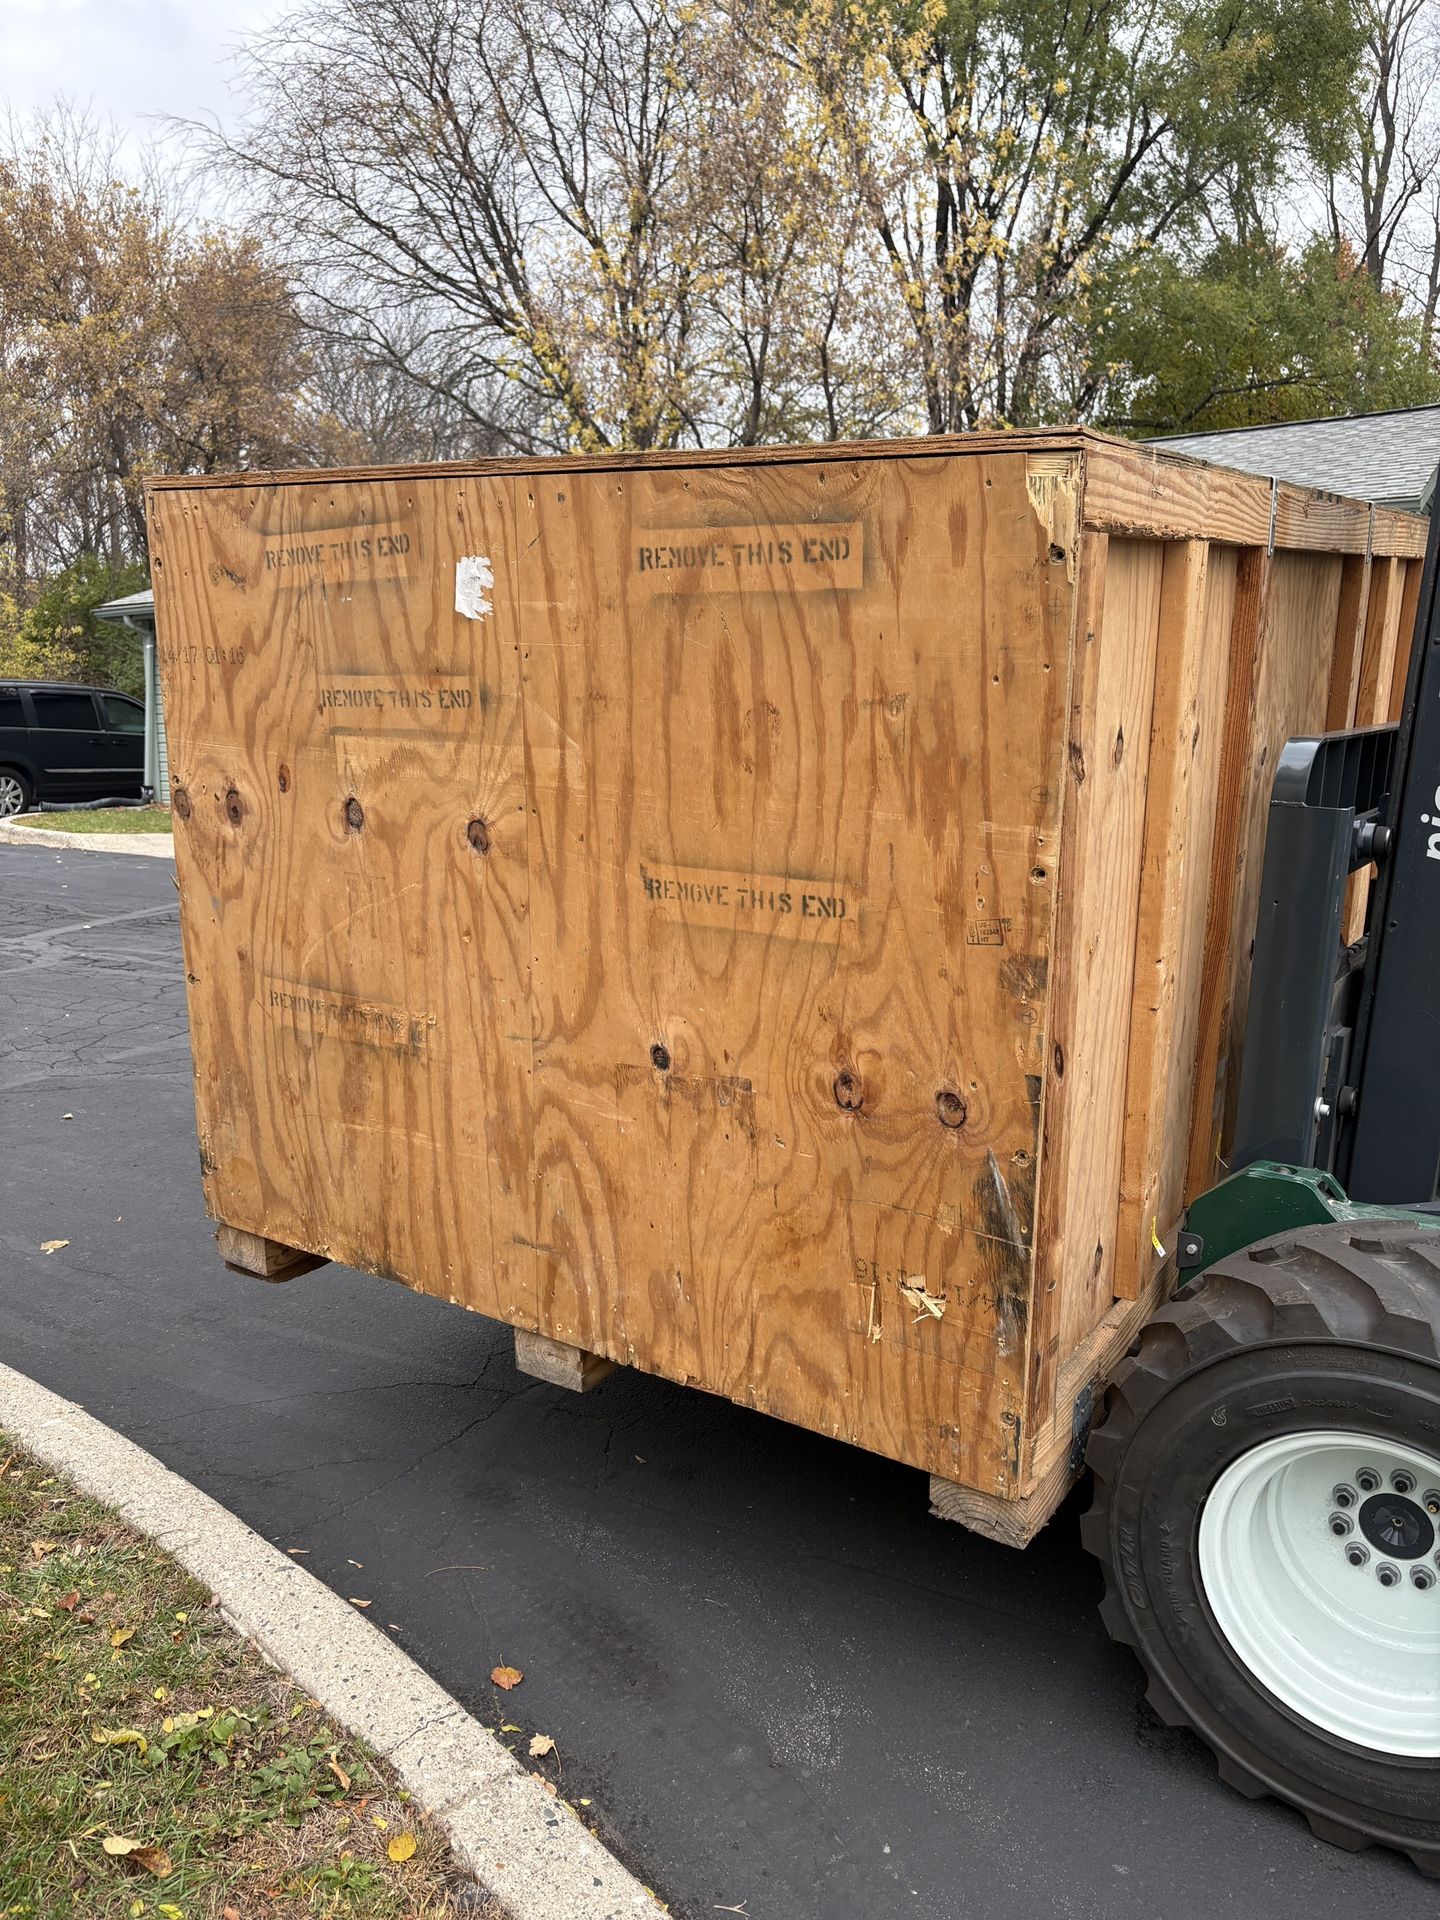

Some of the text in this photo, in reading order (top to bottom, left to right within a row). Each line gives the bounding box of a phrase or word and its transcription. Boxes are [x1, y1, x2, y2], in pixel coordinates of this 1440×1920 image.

[266, 533, 410, 570] REMOVE THIS END
[639, 536, 850, 571] REMOVE THIS END
[321, 688, 472, 709] REMOVE THIS END
[646, 878, 846, 919] REMOVE THIS END
